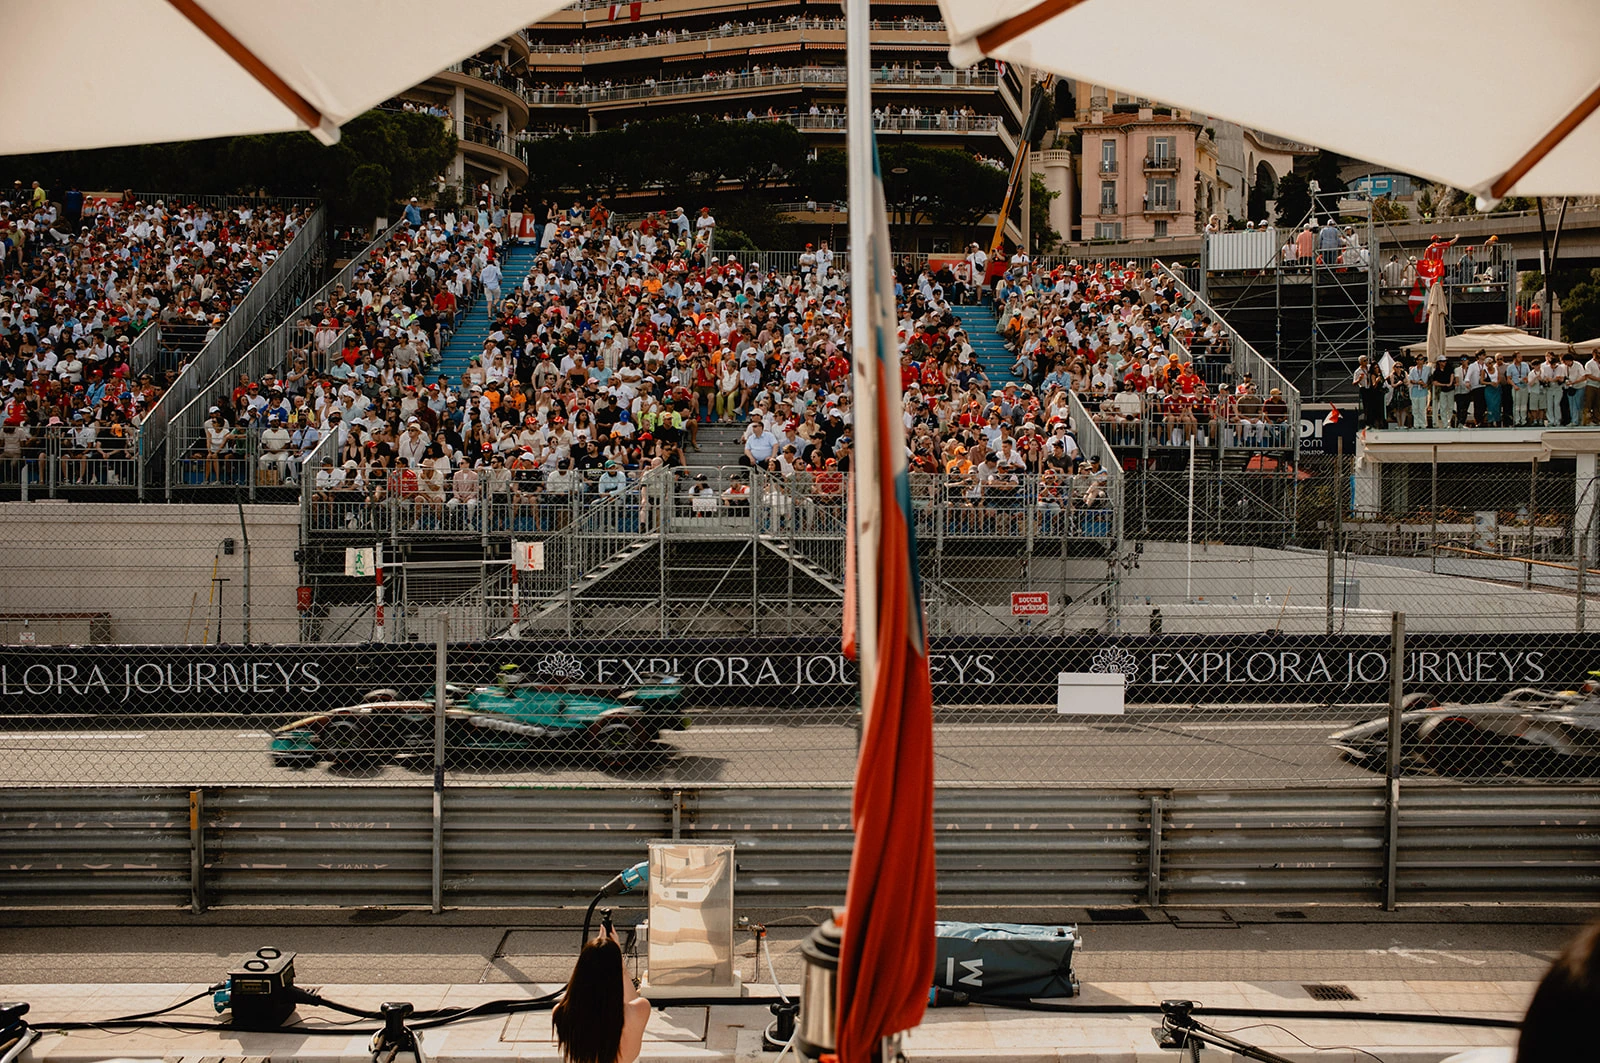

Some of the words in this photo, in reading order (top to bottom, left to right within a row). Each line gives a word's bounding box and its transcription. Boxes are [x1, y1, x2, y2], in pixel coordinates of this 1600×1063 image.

[1, 664, 110, 695] LORA
[120, 662, 321, 703] JOURNEYS
[791, 655, 996, 695] JOUEYS
[1151, 652, 1333, 684] EXPLORA
[1342, 651, 1545, 691] JOURNEYS
